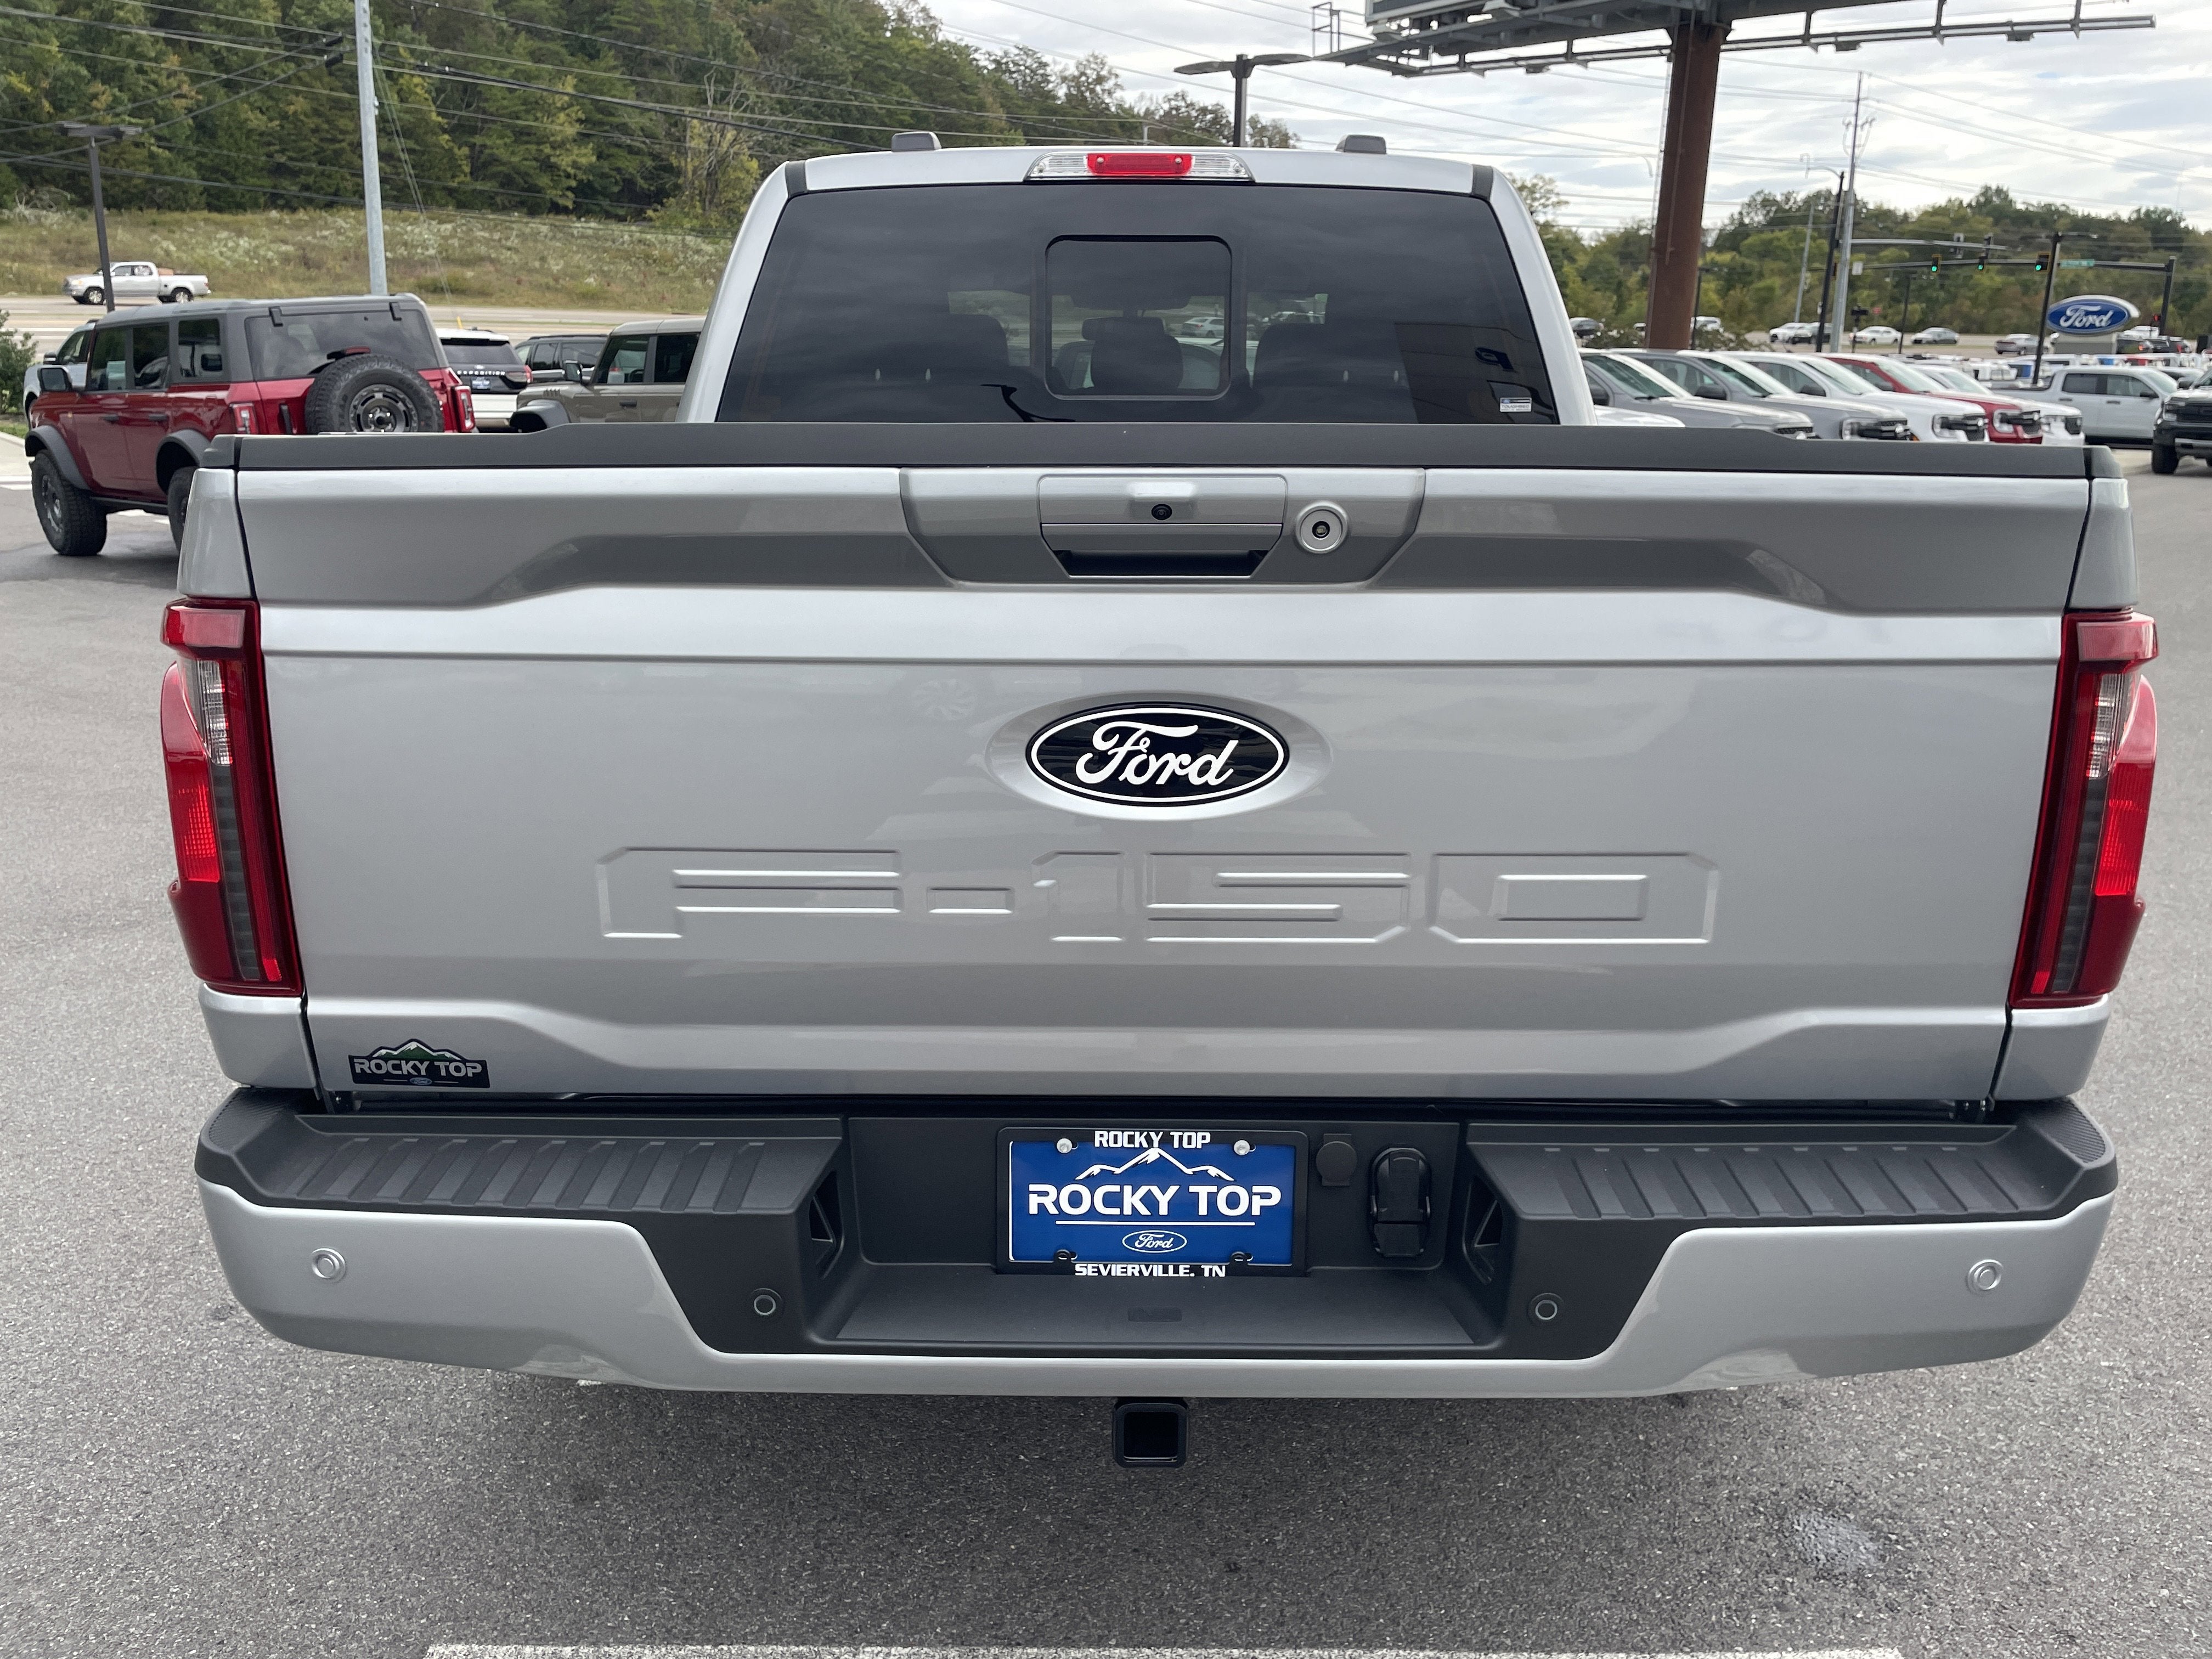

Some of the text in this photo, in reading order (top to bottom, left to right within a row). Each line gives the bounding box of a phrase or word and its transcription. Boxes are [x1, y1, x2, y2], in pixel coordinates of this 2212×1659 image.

[2059, 304, 2114, 328] Ford
[1076, 721, 1239, 786] Ford
[595, 847, 1719, 945] F-150
[354, 1058, 482, 1077] ROCKY TOP
[1094, 1130, 1211, 1149] ROCKY TOP
[1029, 1183, 1282, 1216] ROCKY TOP
[1135, 1233, 1174, 1248] Ford
[1200, 1265, 1226, 1277] TN
